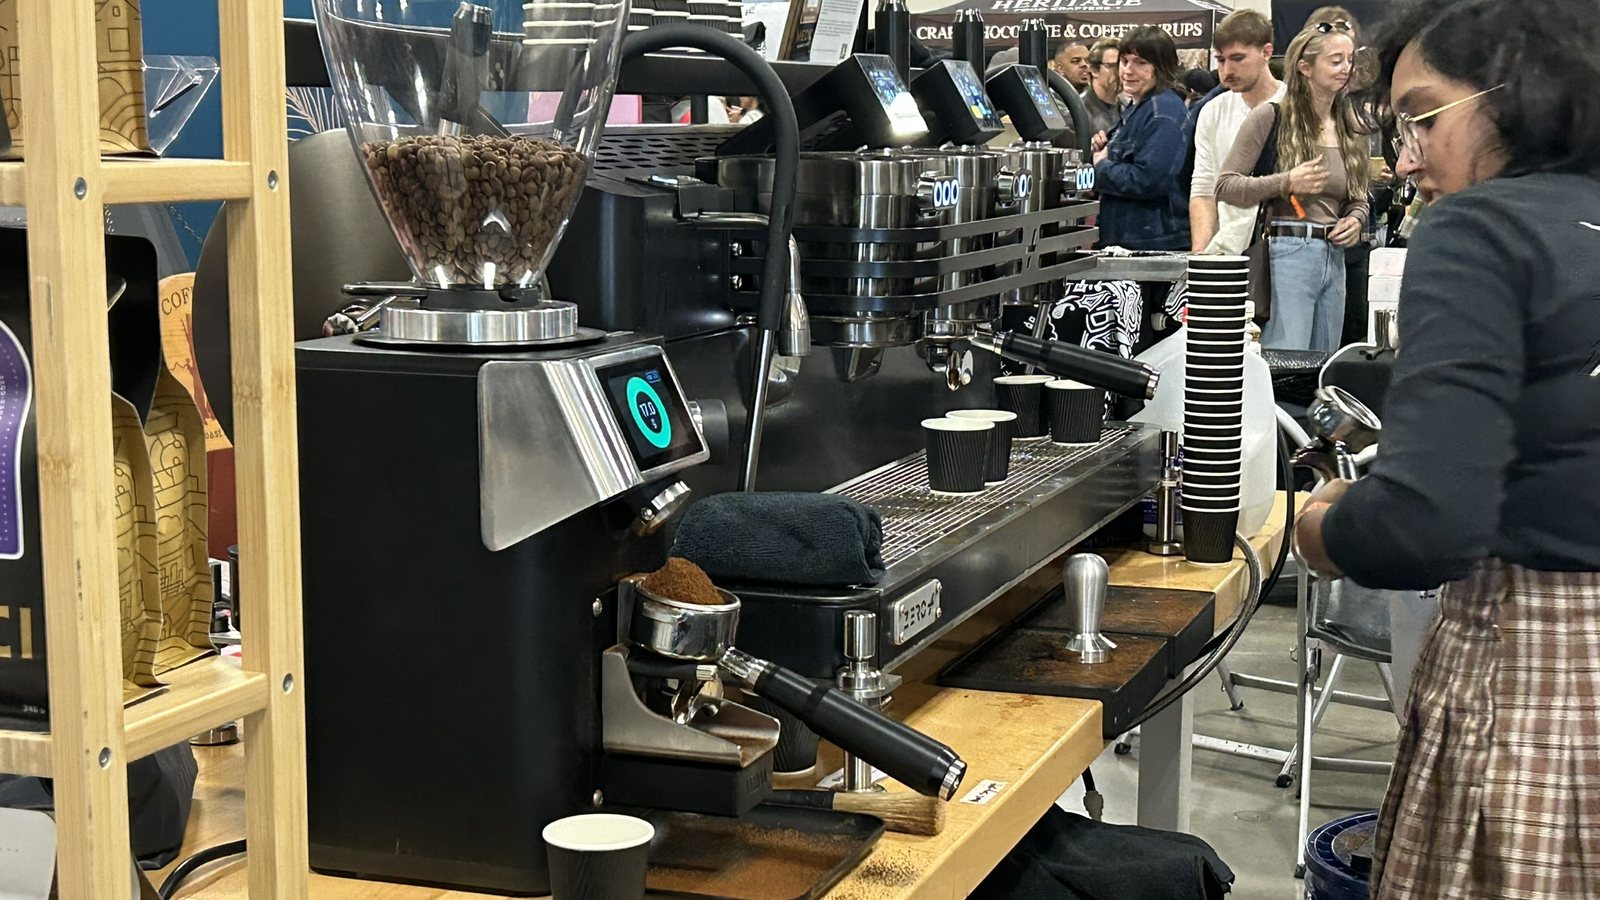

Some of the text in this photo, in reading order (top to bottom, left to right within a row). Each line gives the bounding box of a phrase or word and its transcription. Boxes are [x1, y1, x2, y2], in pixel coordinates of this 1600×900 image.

[991, 0, 1143, 10] HERITAGE
[916, 22, 1203, 40] CRAF HOCOTE & COFFE RUPS
[161, 286, 193, 316] COF
